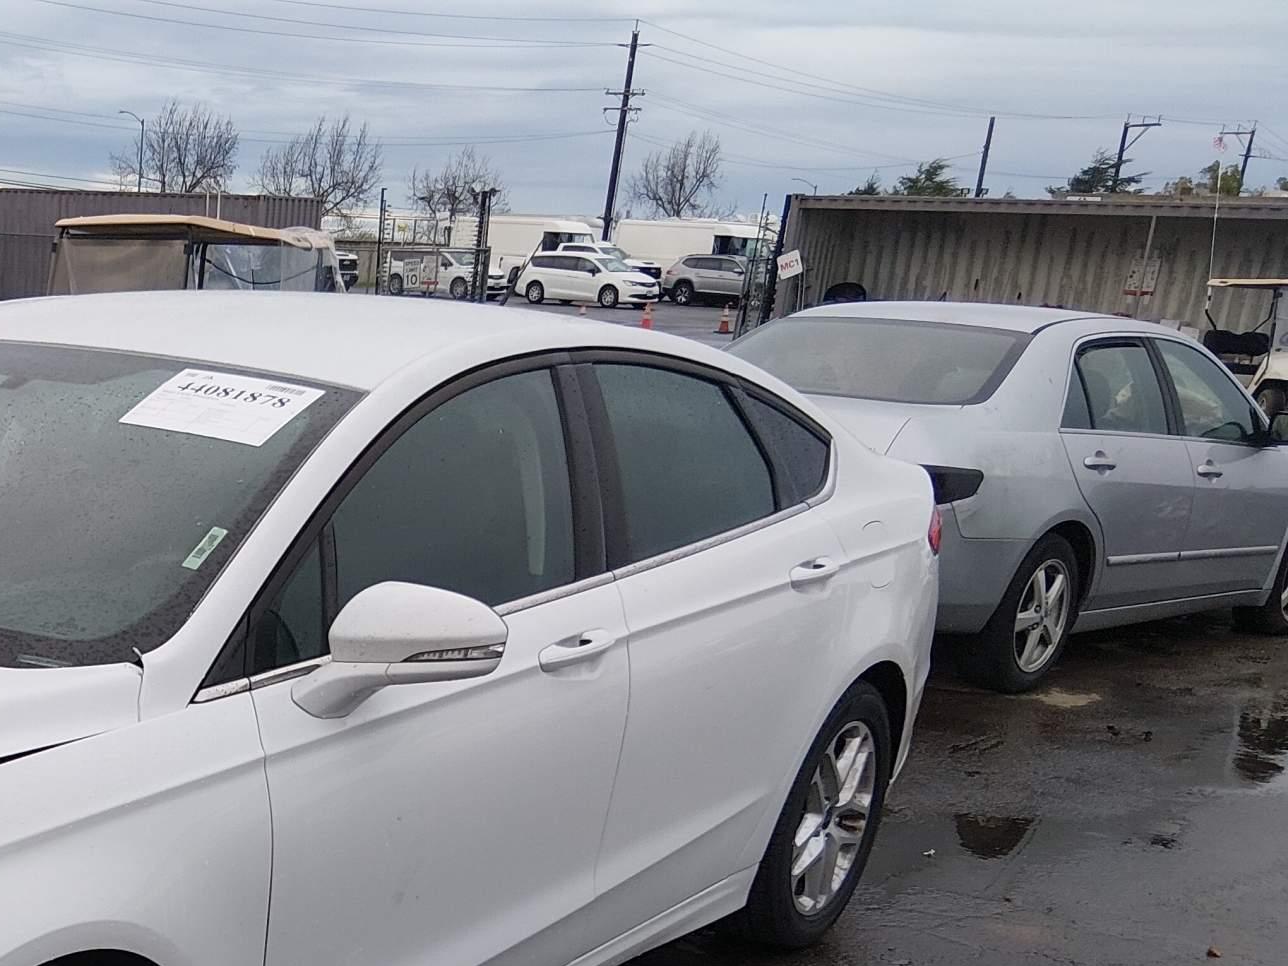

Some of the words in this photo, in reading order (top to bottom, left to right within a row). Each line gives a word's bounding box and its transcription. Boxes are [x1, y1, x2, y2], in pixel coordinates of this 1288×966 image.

[780, 258, 800, 272] MC1
[406, 274, 418, 286] 10
[178, 381, 291, 409] 44081878
